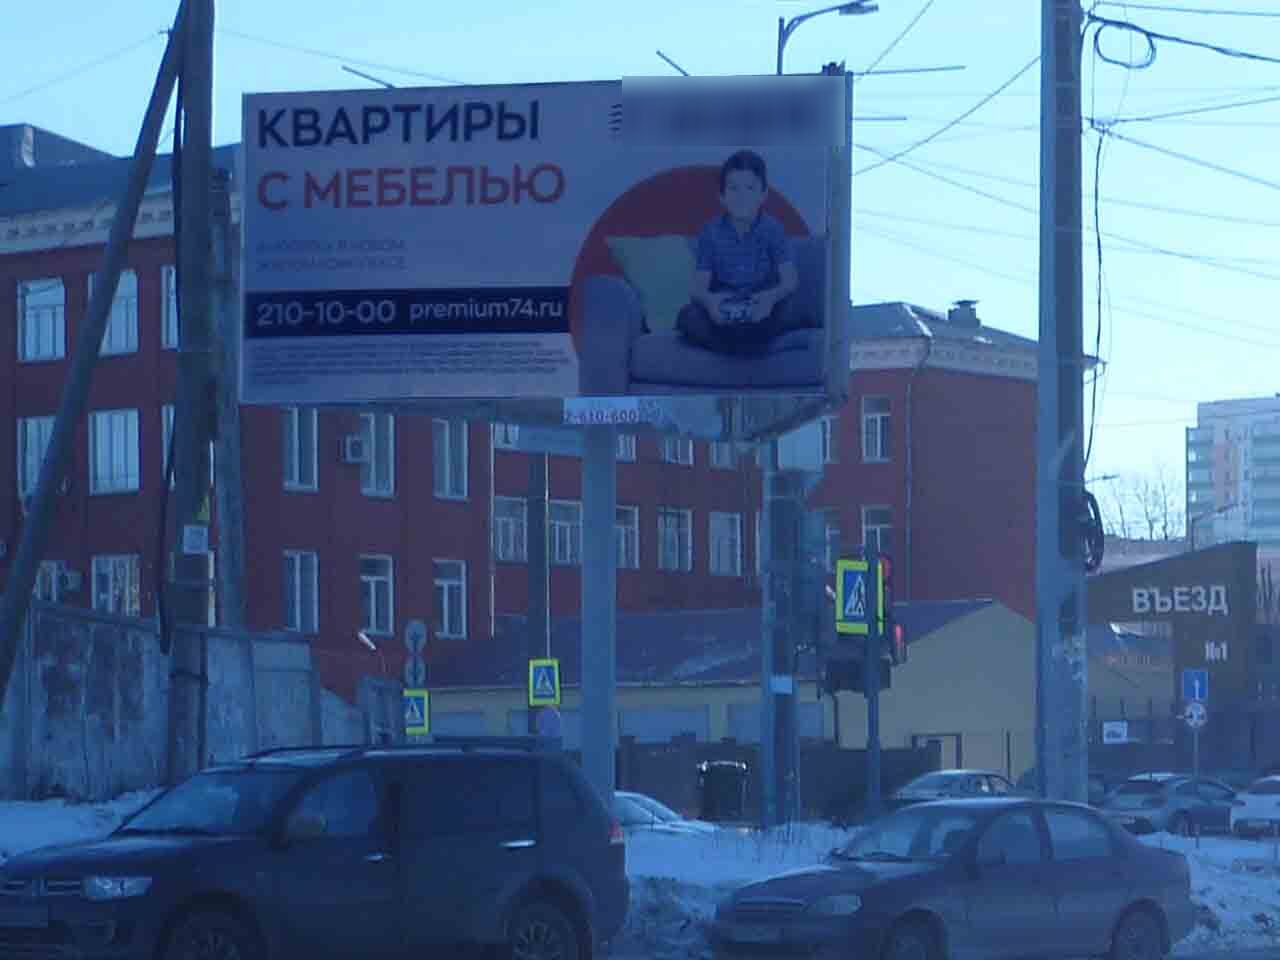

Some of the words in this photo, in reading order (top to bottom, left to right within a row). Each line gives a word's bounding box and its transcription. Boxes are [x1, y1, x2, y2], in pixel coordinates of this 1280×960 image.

[257, 100, 539, 148] КВАРТИРЫ
[256, 170, 290, 210] С
[303, 162, 565, 209] МЕБЕЛЬЮ
[256, 299, 397, 326] 210-10-00
[409, 297, 563, 321] premium74.ru
[1132, 585, 1229, 616] ВЪЕЗД
